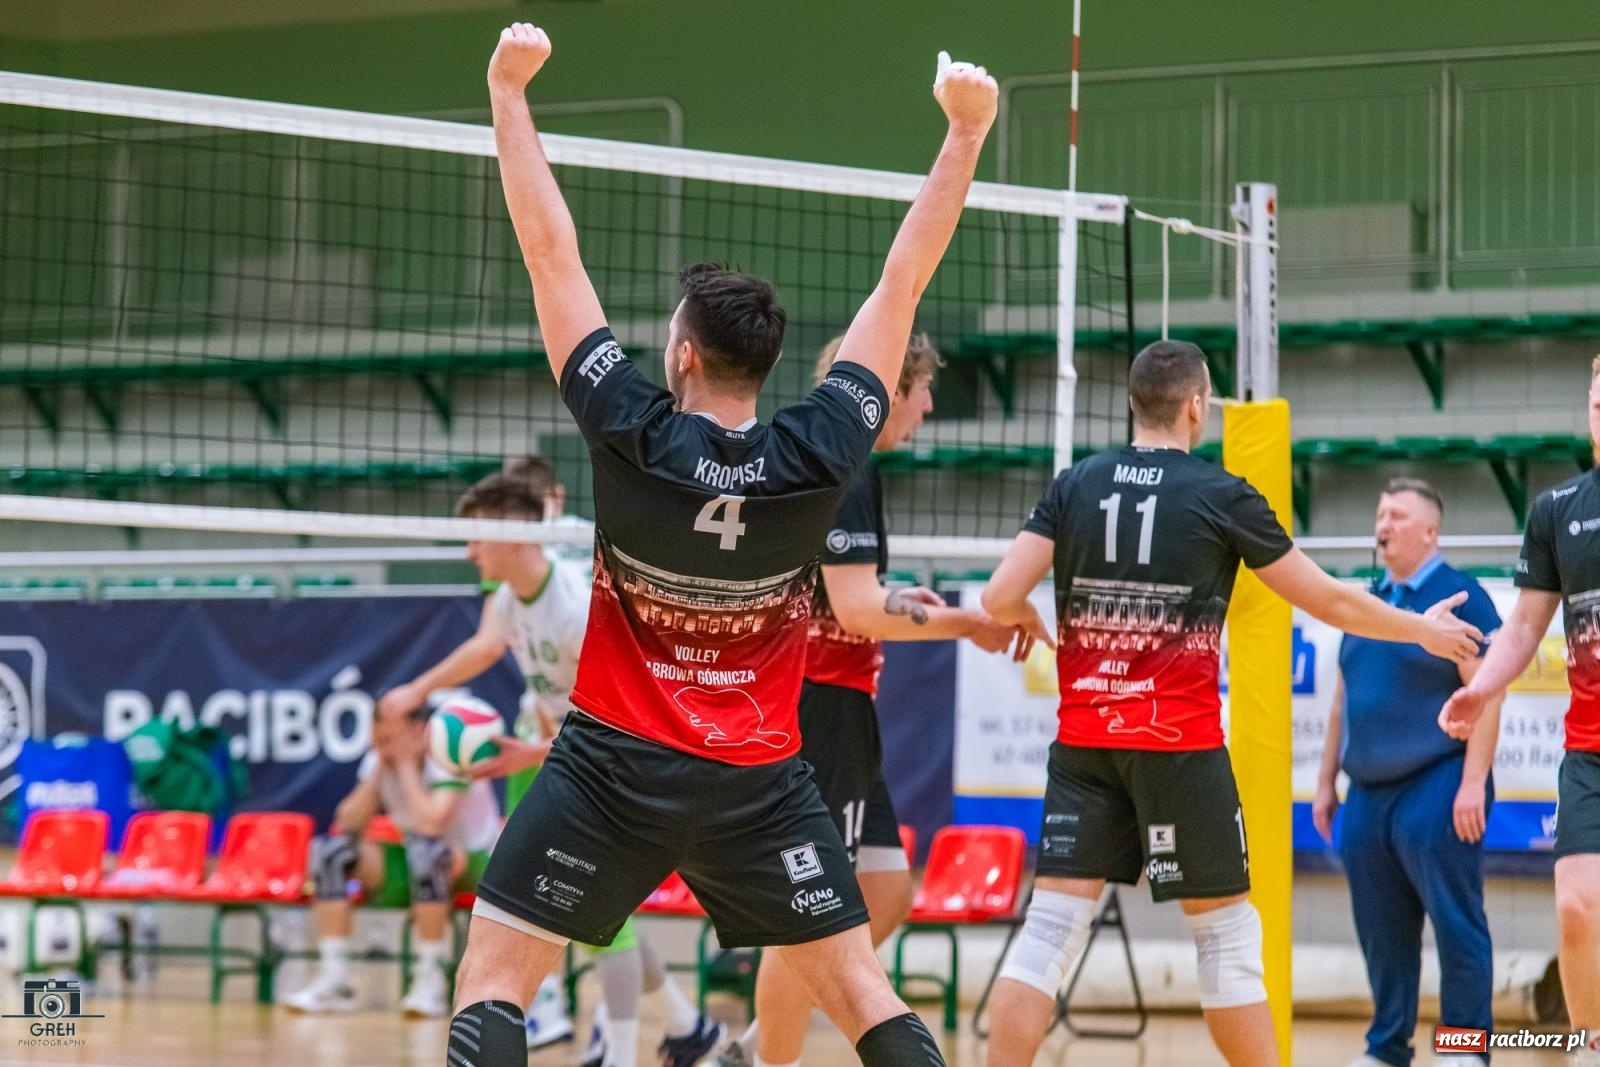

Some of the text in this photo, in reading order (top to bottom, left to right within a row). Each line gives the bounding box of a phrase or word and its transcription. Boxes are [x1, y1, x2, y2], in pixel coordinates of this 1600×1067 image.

[587, 346, 628, 388] OFIT
[693, 456, 767, 490] KROPISZ
[1113, 464, 1164, 486] MADEJ
[693, 494, 746, 551] 4
[1099, 492, 1158, 565] 11
[674, 645, 720, 664] VOLLEY
[646, 661, 756, 686] BROWA GÓRNICZA
[796, 888, 834, 908] NEMO
